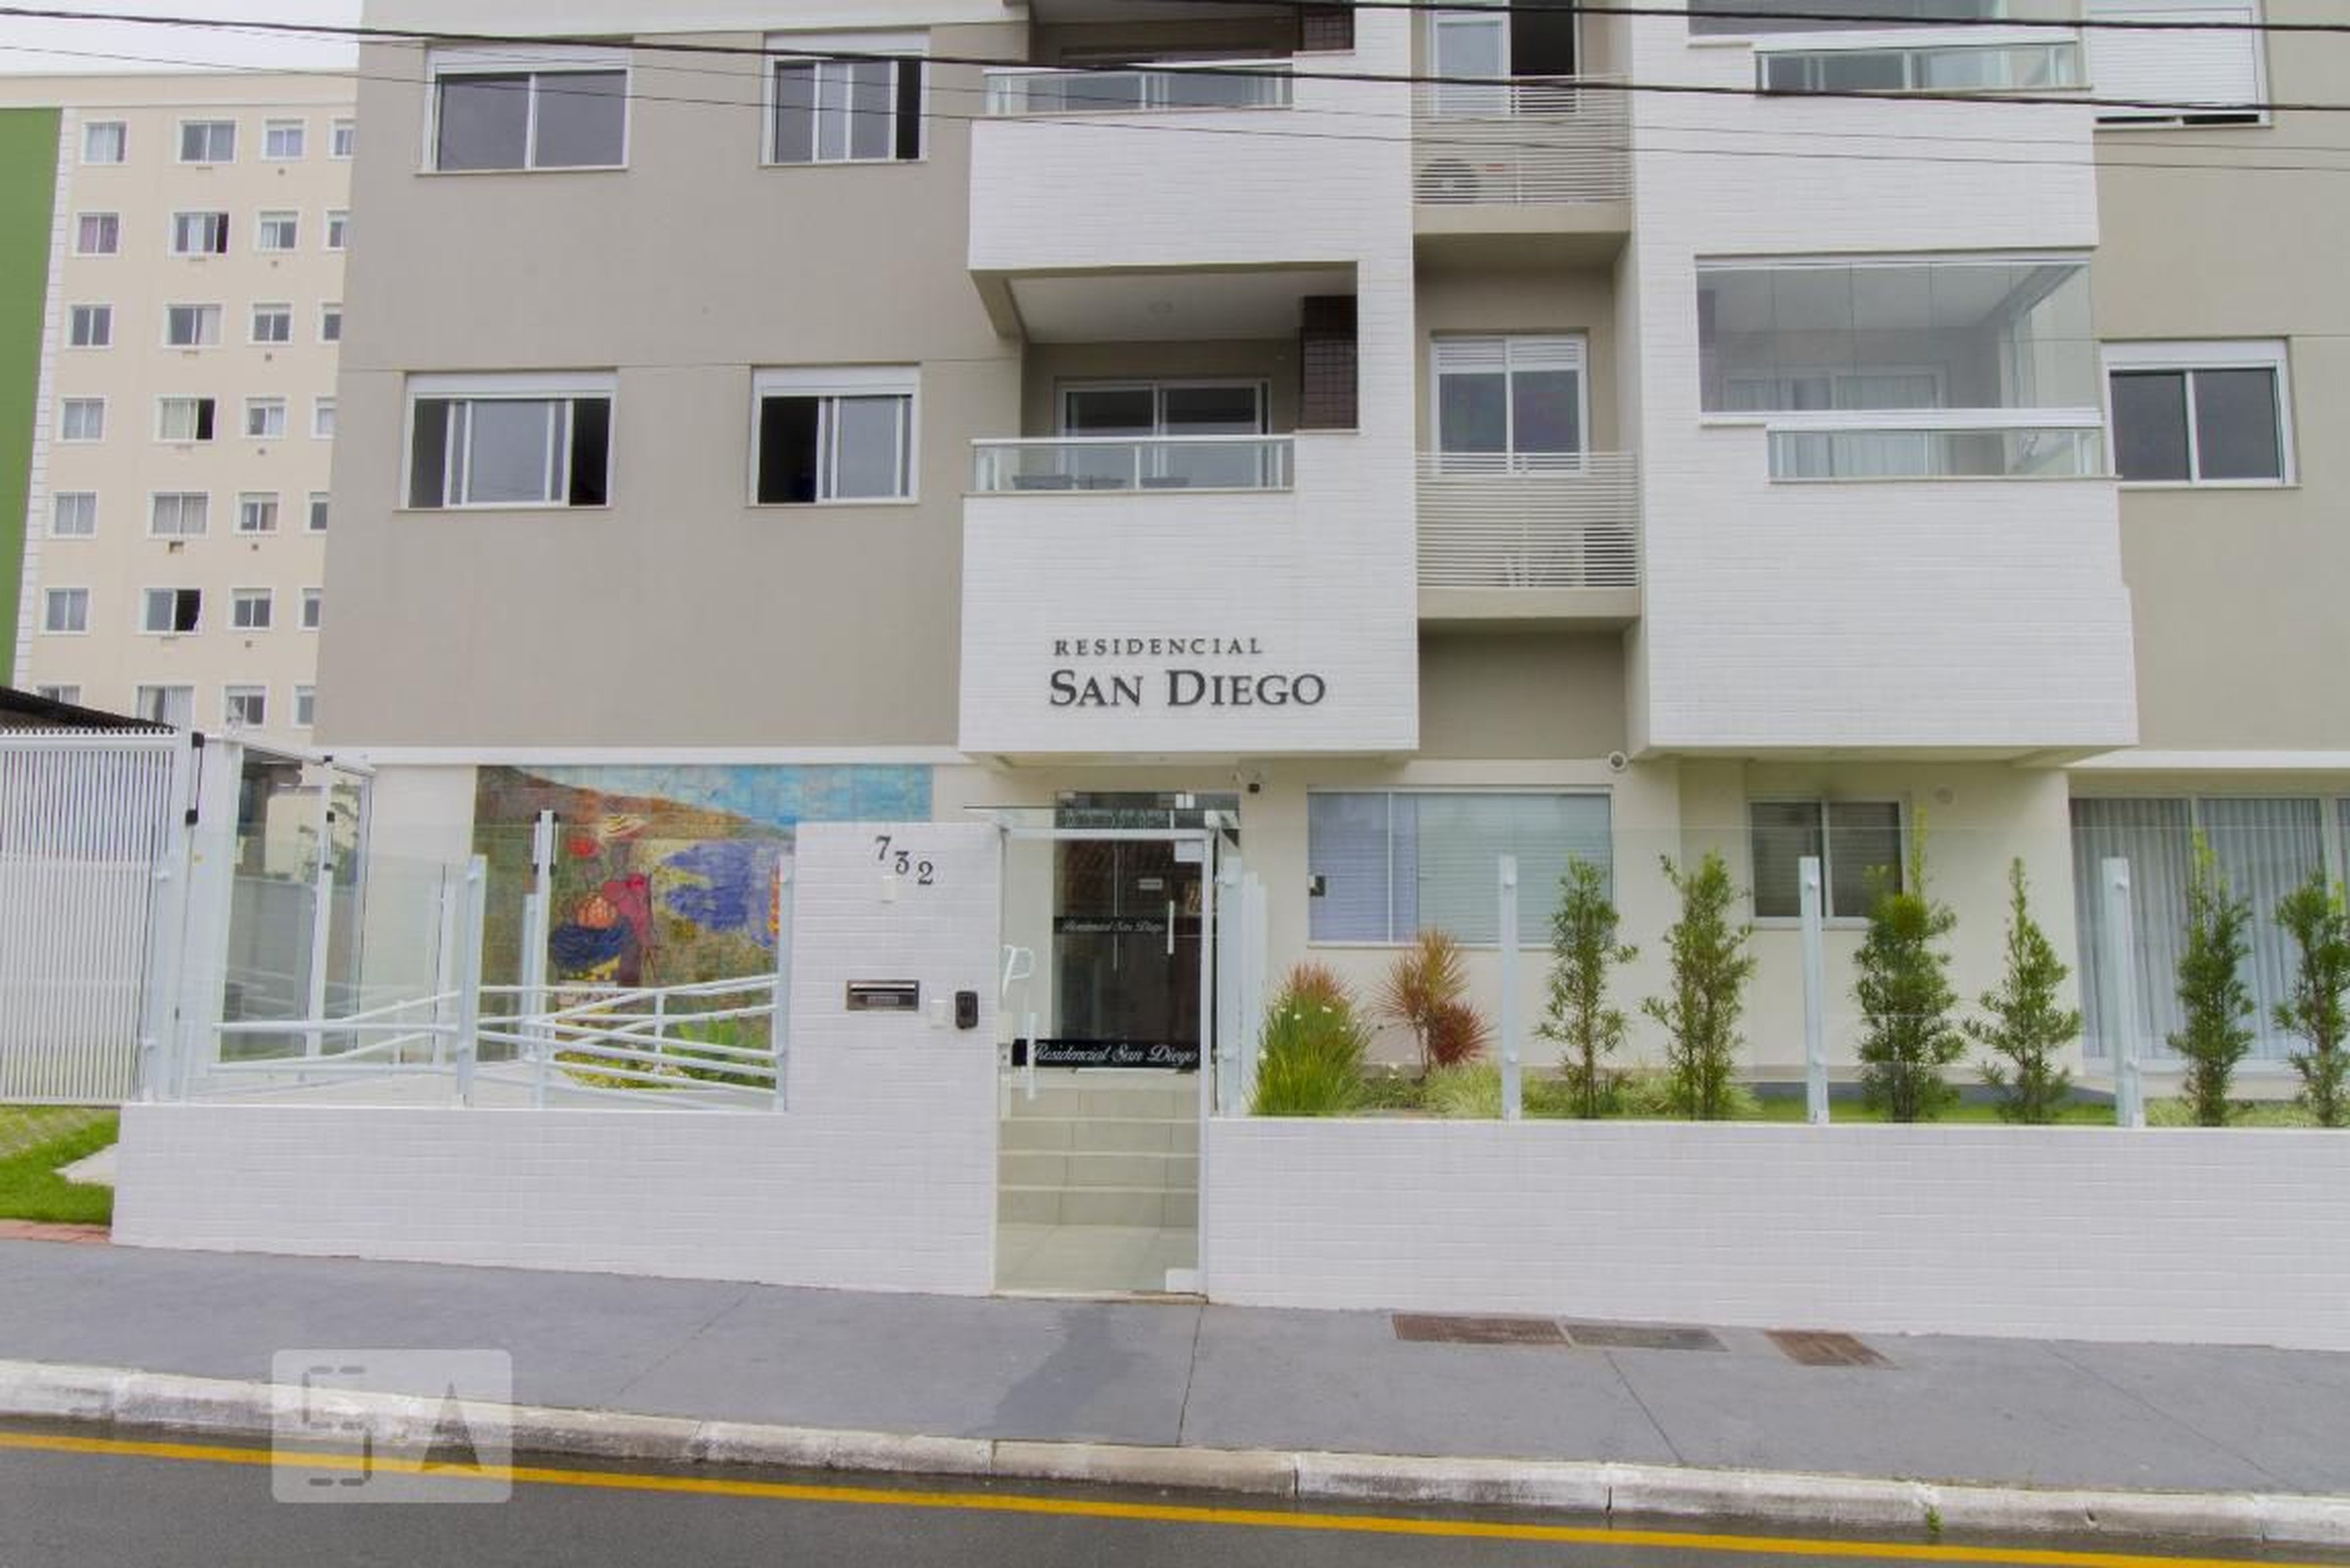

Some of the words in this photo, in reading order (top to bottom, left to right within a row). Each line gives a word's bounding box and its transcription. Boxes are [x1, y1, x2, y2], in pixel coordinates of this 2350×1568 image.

[1054, 637, 1263, 657] RESIDENCIAL
[1050, 669, 1144, 707] SAN
[1165, 669, 1326, 707] DIEGO
[876, 835, 934, 886] 732
[1111, 1042, 1144, 1062] San
[1147, 1043, 1198, 1066] Diego
